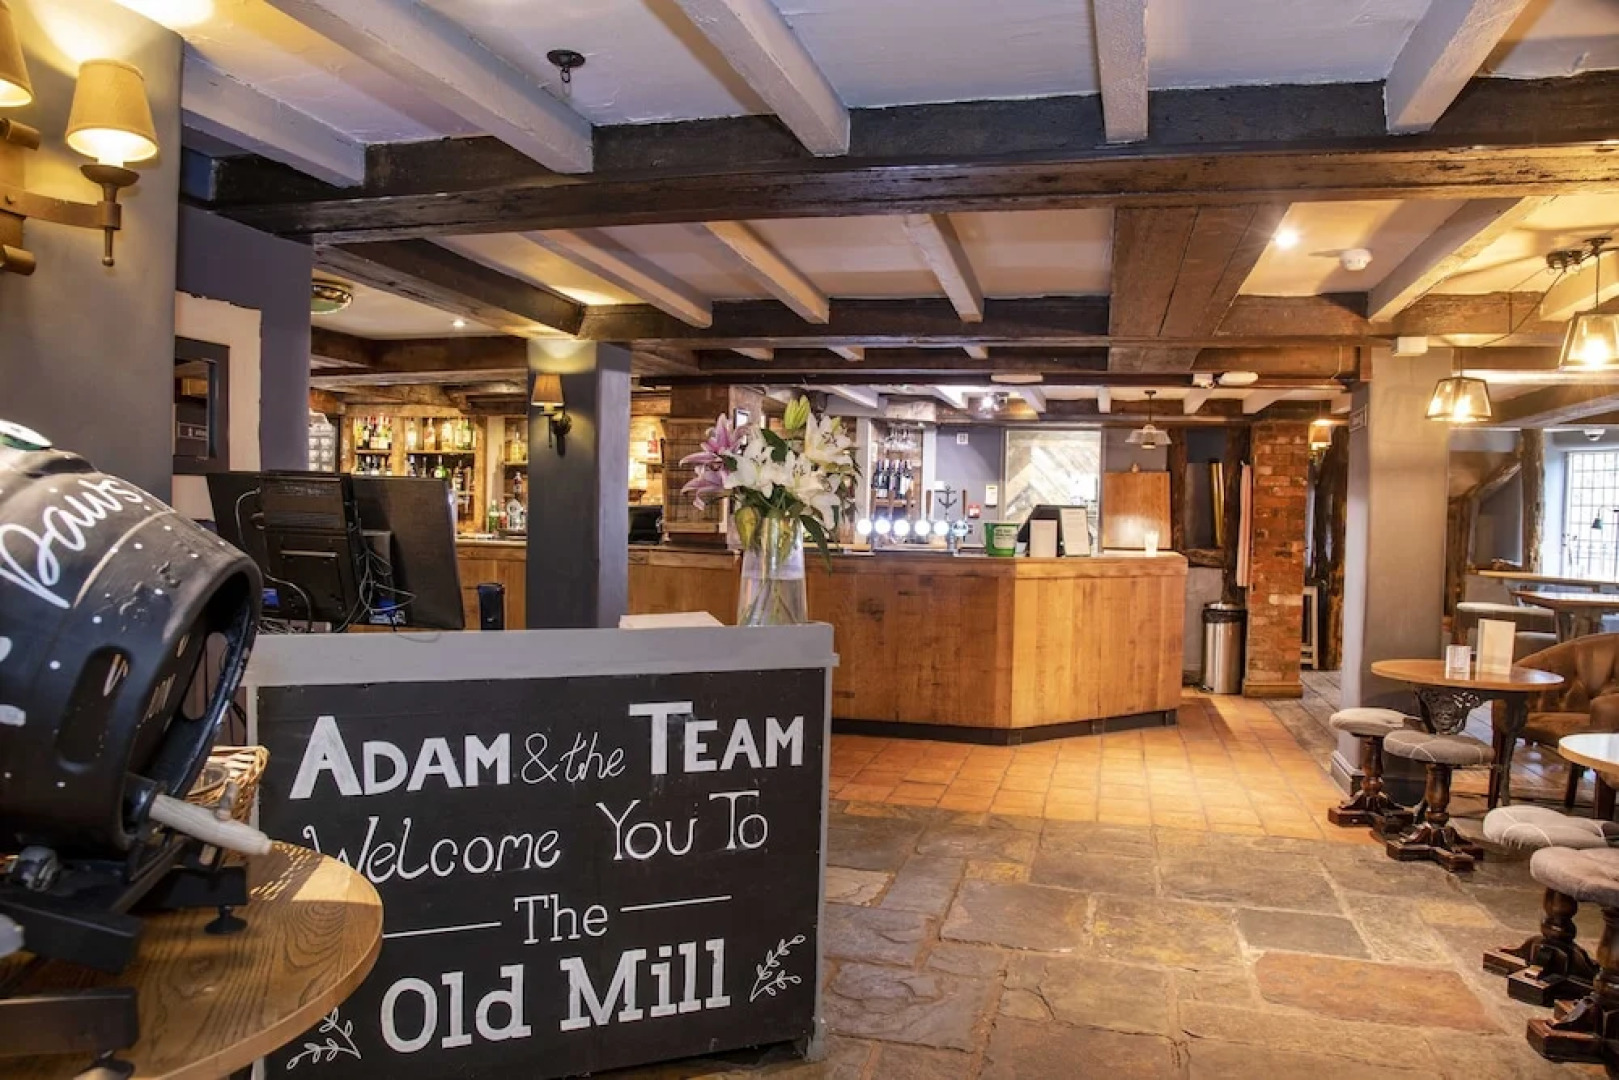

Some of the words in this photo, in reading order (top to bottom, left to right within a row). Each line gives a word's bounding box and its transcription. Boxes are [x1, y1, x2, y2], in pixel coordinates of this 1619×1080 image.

[290, 716, 510, 798] ADAM
[521, 733, 556, 783] &
[558, 732, 625, 782] the
[629, 701, 803, 775] TEAM
[596, 799, 698, 860] You
[709, 790, 768, 850] To
[514, 894, 608, 944] The
[381, 965, 531, 1052] Old
[560, 938, 730, 1031] Mill
